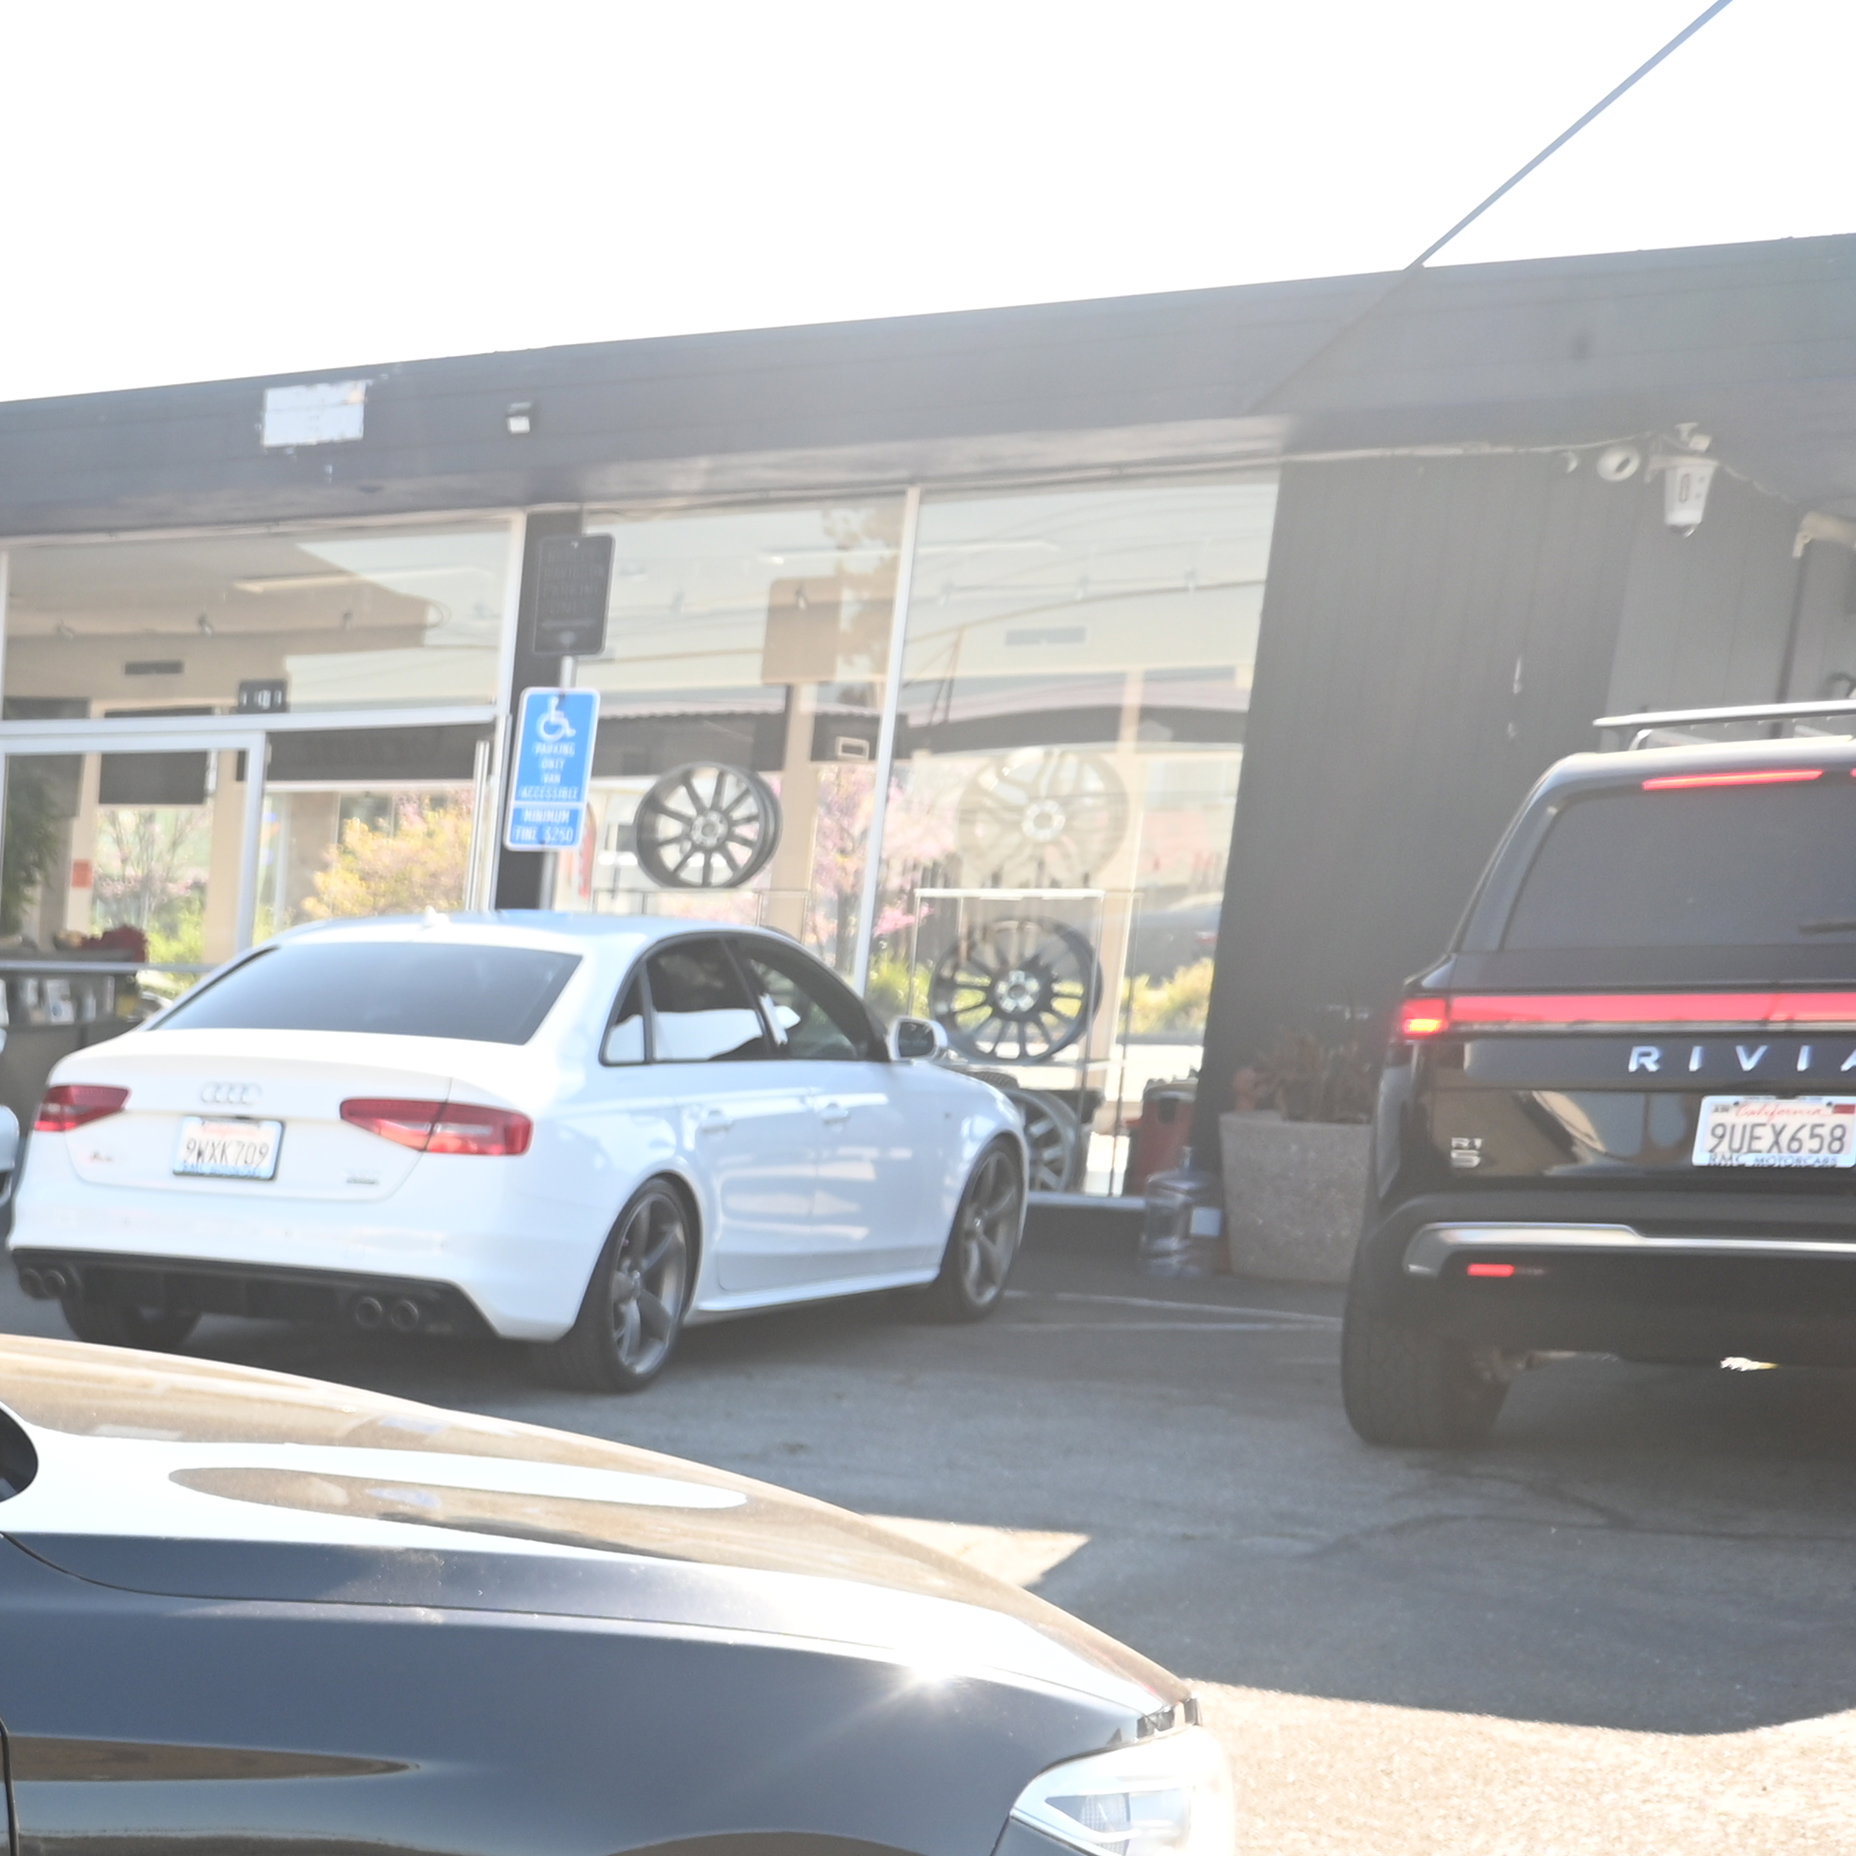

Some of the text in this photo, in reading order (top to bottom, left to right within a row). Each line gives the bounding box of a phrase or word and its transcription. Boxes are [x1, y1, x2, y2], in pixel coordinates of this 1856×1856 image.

[533, 742, 575, 756] PARKING
[541, 758, 565, 769] ONLY
[542, 773, 561, 784] VAN
[523, 809, 570, 823] MINIMUM
[1708, 1122, 1847, 1155] 9UEX658
